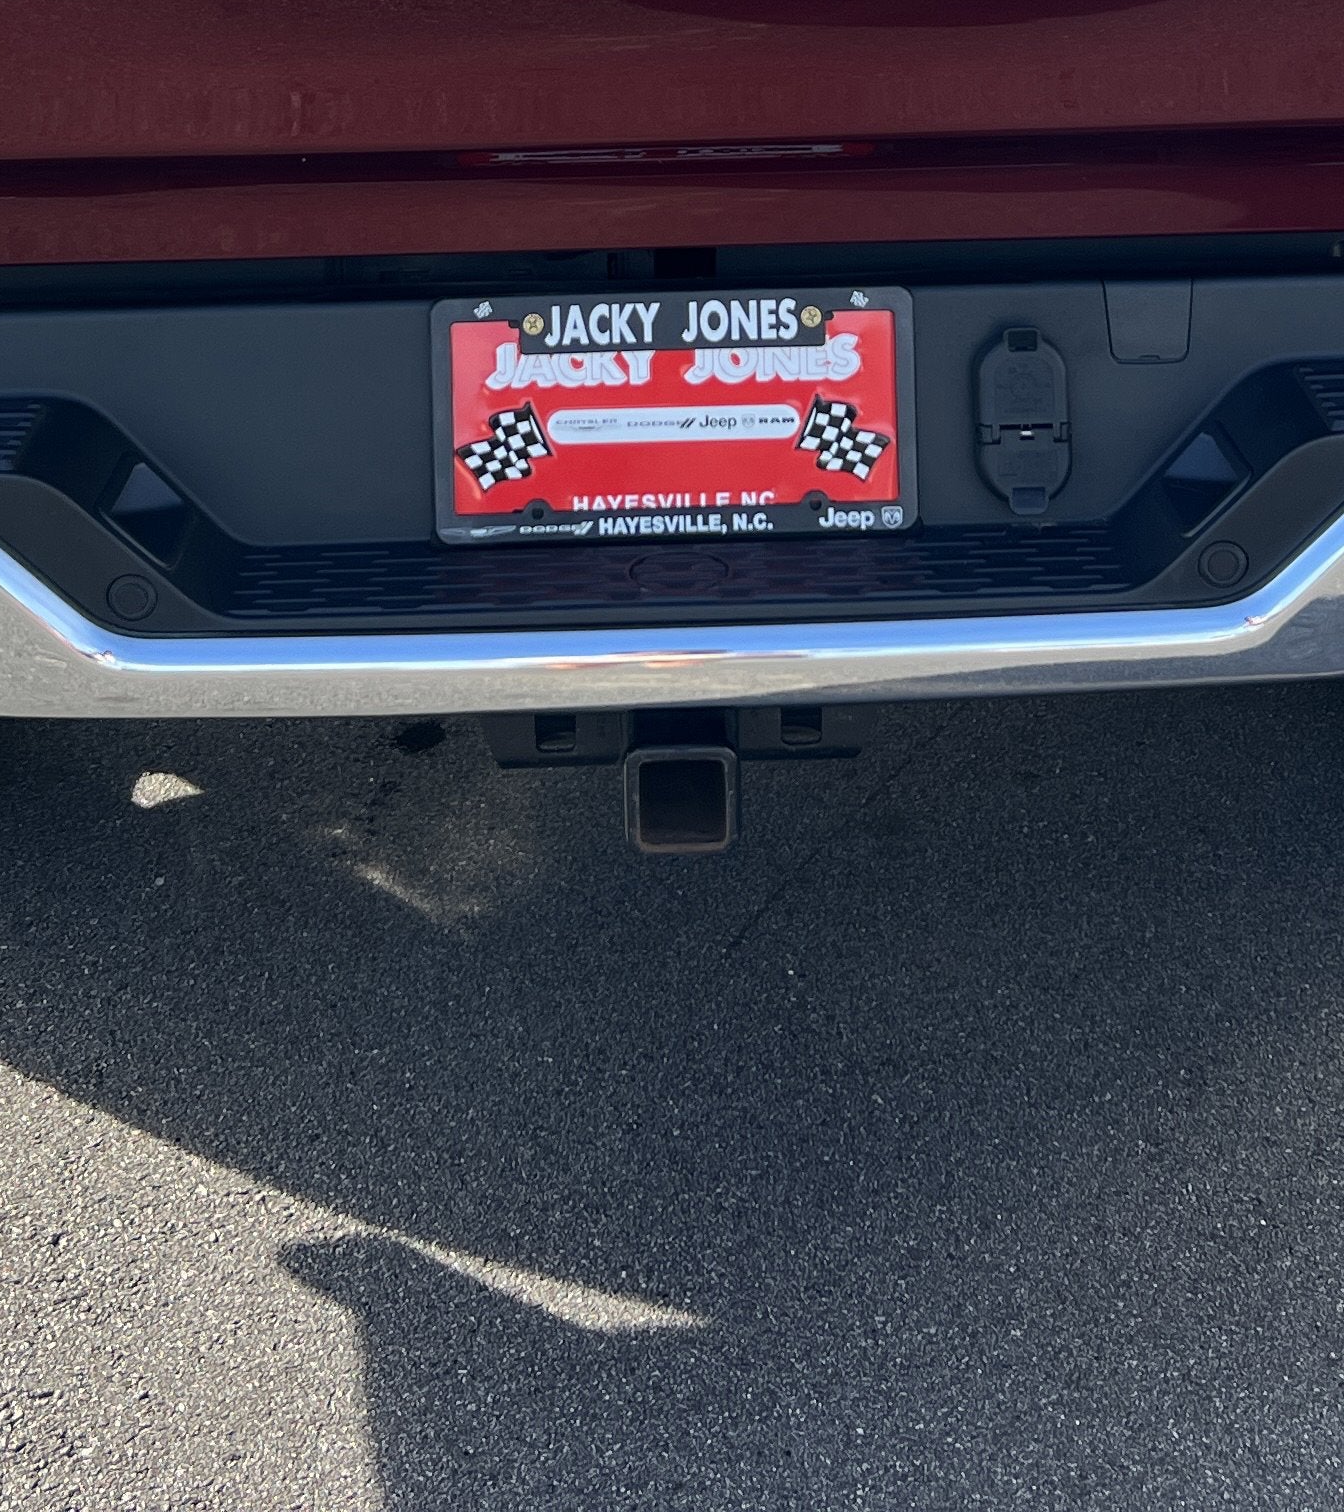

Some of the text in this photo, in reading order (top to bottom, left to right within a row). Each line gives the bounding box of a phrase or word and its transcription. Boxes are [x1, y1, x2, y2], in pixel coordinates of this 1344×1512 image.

[544, 297, 799, 348] JACKY JONES
[485, 333, 862, 390] JACKY JONES
[699, 414, 737, 430] Jeep
[598, 513, 728, 535] HAYESVILLE,
[732, 512, 774, 531] N.C.
[818, 506, 875, 530] Jeep
